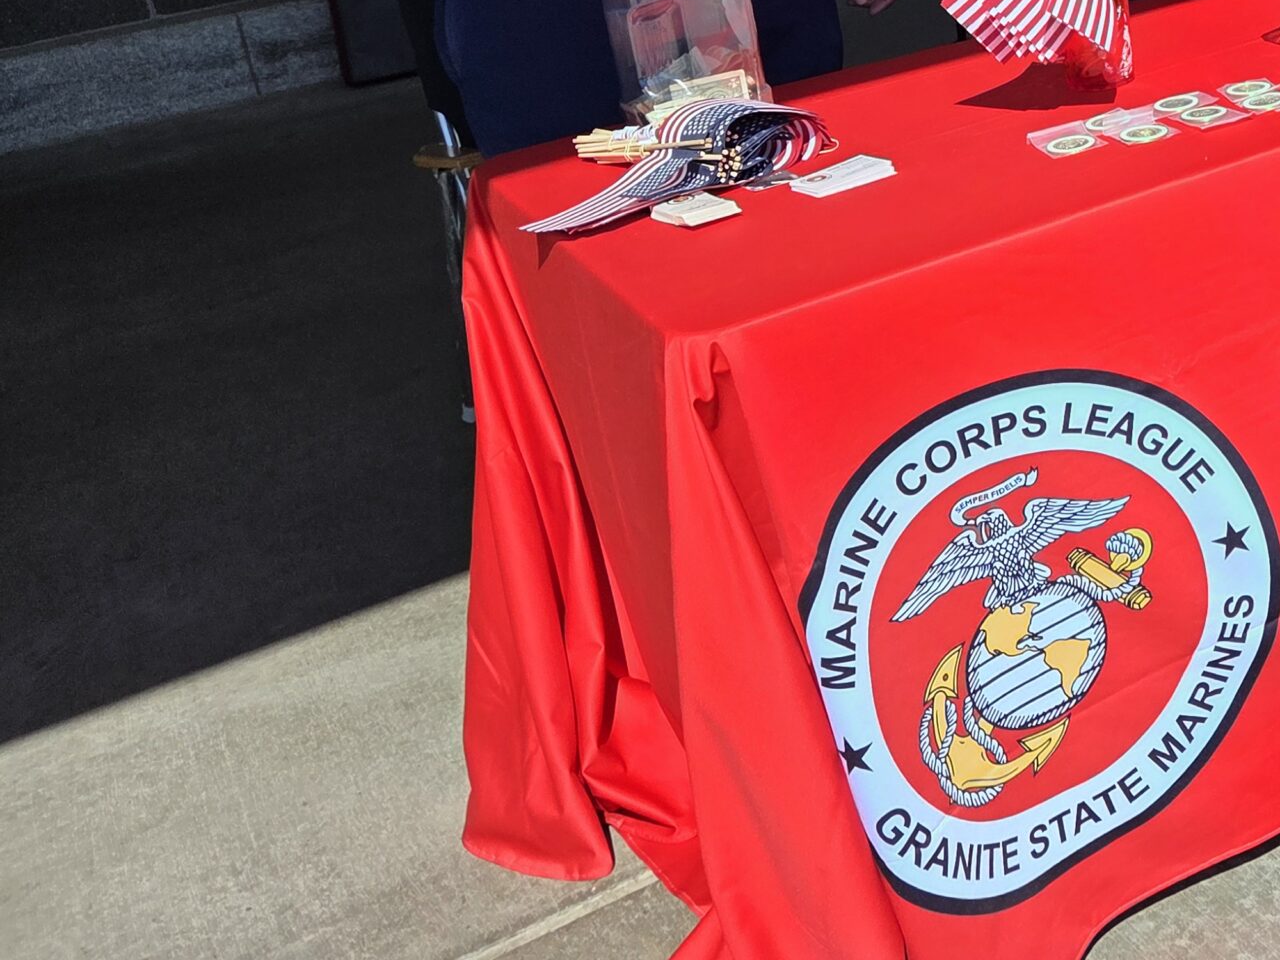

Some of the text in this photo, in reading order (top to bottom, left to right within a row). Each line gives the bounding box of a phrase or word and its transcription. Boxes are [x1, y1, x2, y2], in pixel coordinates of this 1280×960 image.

[820, 402, 1215, 689] MARINE CORPS LEAGUE
[955, 476, 1023, 514] SEMPER FIDELIS
[875, 594, 1255, 881] GRANITE STATE MARINES
